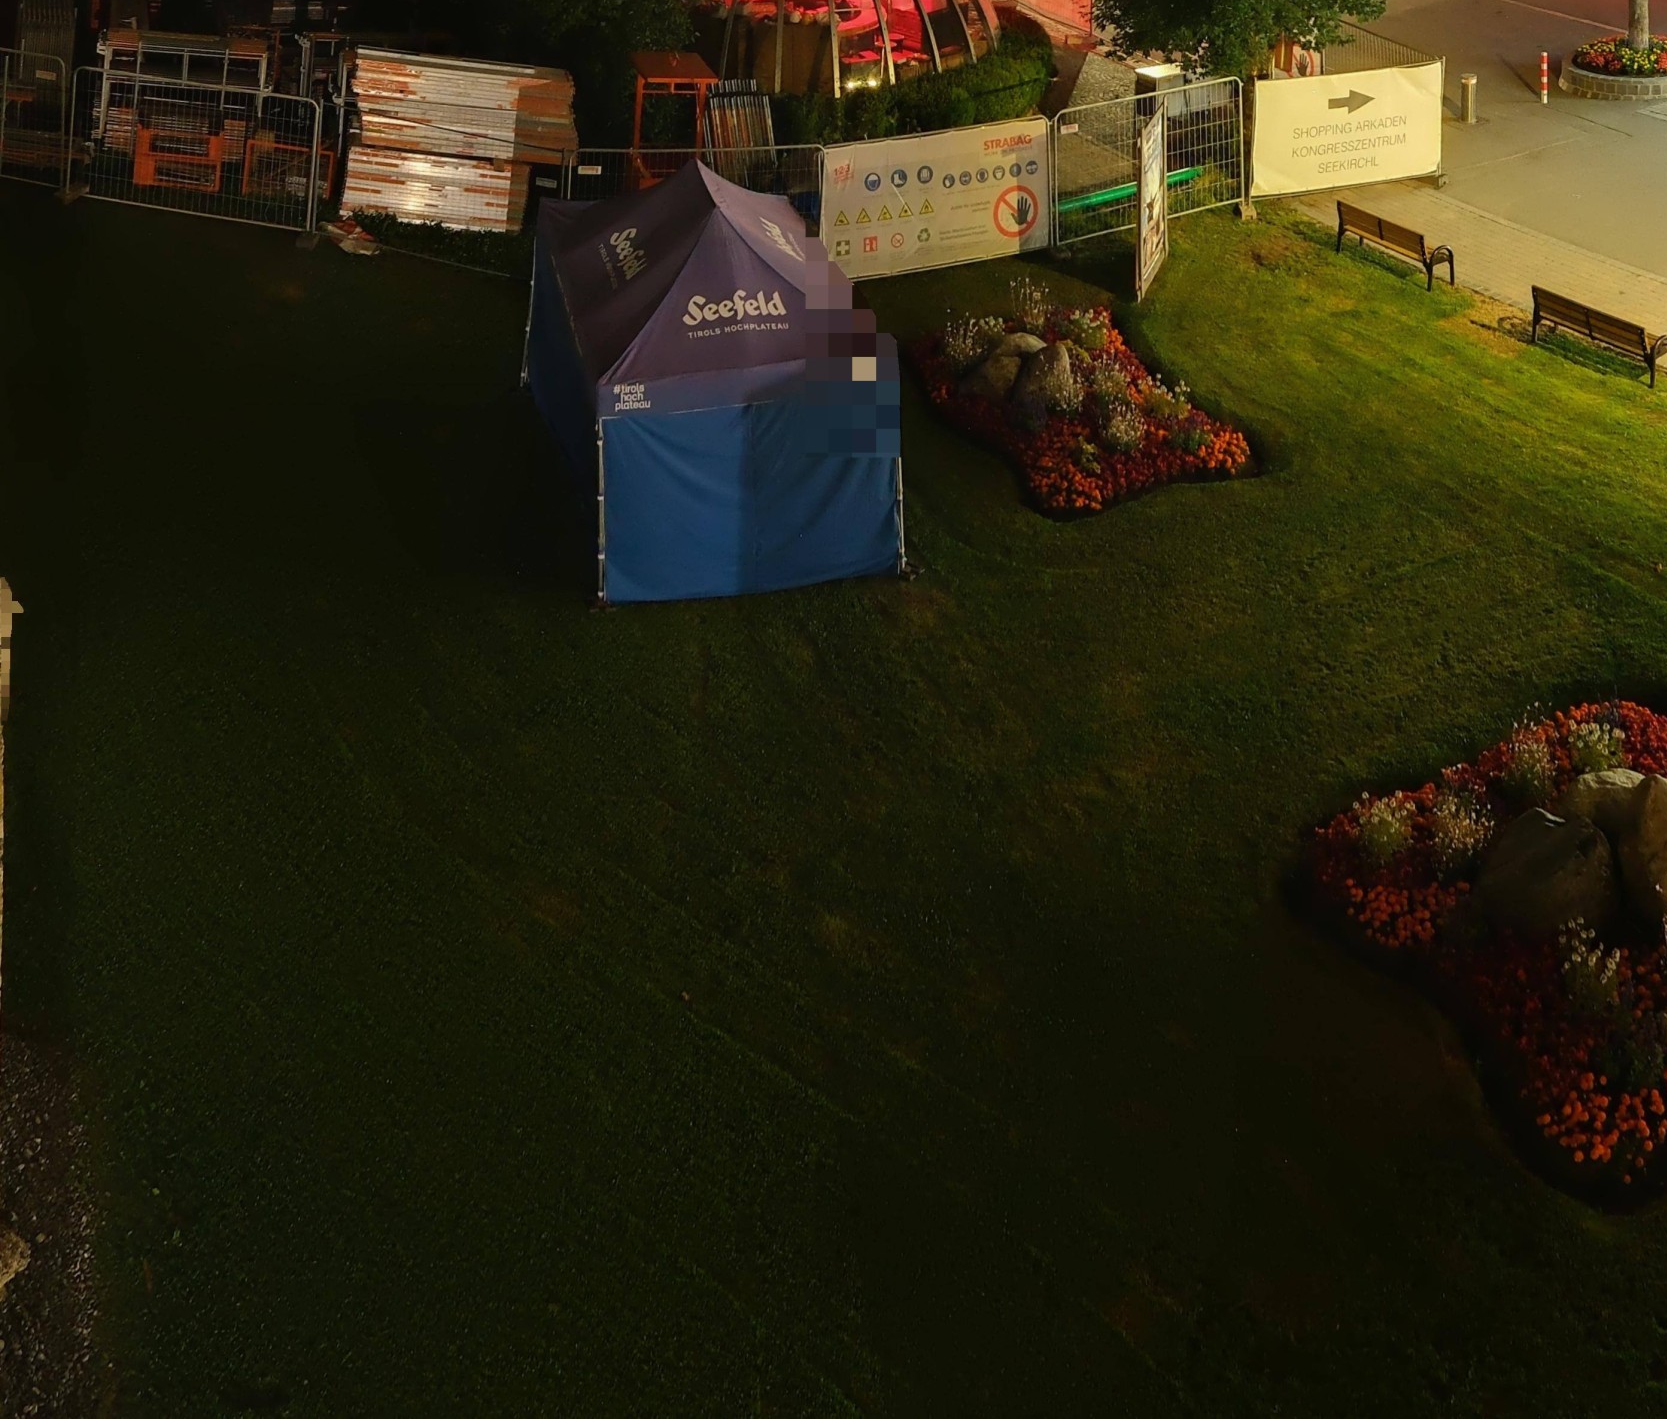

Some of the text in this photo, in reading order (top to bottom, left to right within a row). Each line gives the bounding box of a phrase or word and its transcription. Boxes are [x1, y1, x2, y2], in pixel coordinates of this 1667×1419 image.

[1292, 114, 1408, 140] SHOPPING ARKADEN
[983, 133, 1033, 151] STRABAG
[1290, 132, 1407, 159] KONGRESSZENTRUM
[1317, 155, 1380, 174] SEEKIRCHL
[610, 227, 647, 281] Seefeld
[682, 288, 788, 326] Seefeld
[687, 322, 789, 339] TIROLS HOCHPLATEAU
[613, 383, 645, 396] #tirols
[620, 391, 644, 402] hoch
[614, 399, 651, 412] plateau
